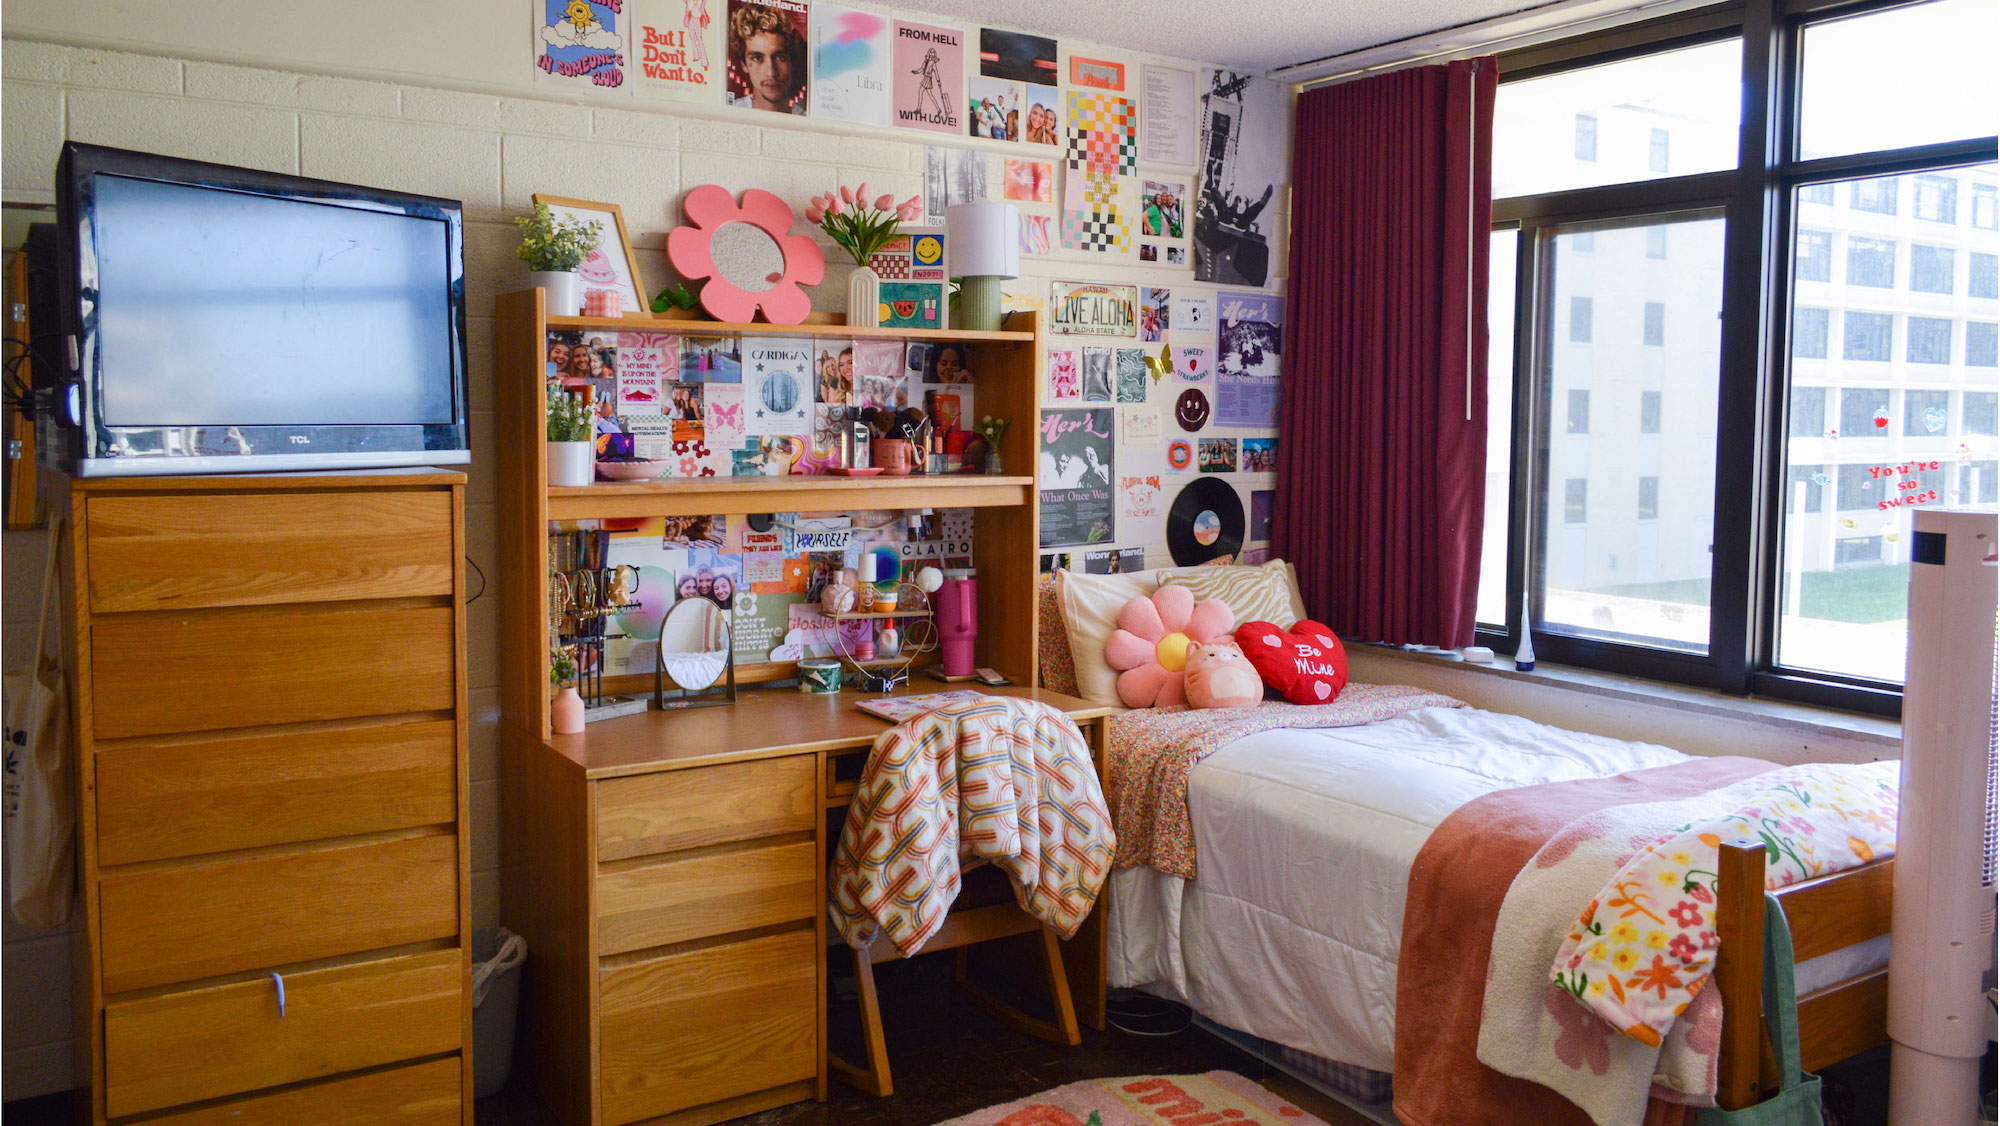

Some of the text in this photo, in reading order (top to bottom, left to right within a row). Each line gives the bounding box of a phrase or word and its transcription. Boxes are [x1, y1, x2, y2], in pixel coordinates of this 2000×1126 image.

[642, 26, 685, 48] But I
[899, 27, 957, 46] FROM HELL
[537, 53, 553, 74] IN
[642, 44, 687, 66] Don't
[557, 53, 624, 77] SOMEONE'S
[642, 63, 684, 82] Want
[686, 69, 707, 85] to.
[591, 69, 623, 88] CLOUD
[857, 75, 883, 92] Libra
[899, 109, 957, 127] WITH LOVE!
[1082, 286, 1108, 294] HAWAII
[1054, 296, 1134, 327] LIVE ALOHA
[1222, 300, 1280, 328] Her's
[1073, 326, 1116, 335] ALOHA STATE
[751, 350, 808, 361] CARDIGAN
[1183, 348, 1204, 357] SWEET
[1219, 373, 1235, 383] She
[1236, 375, 1260, 384] Needs
[1040, 412, 1109, 444] Her's
[289, 436, 311, 444] TCL
[1868, 460, 1940, 479] You're
[1122, 474, 1161, 492] FLORAL SOUL
[1897, 480, 1918, 491] so
[1041, 489, 1109, 503] What Once Was
[1878, 489, 1938, 511] sweet
[747, 534, 778, 543] FRIENDS
[902, 542, 969, 555] CLAIRO
[1295, 644, 1322, 657] Be
[1294, 658, 1335, 676] Mine
